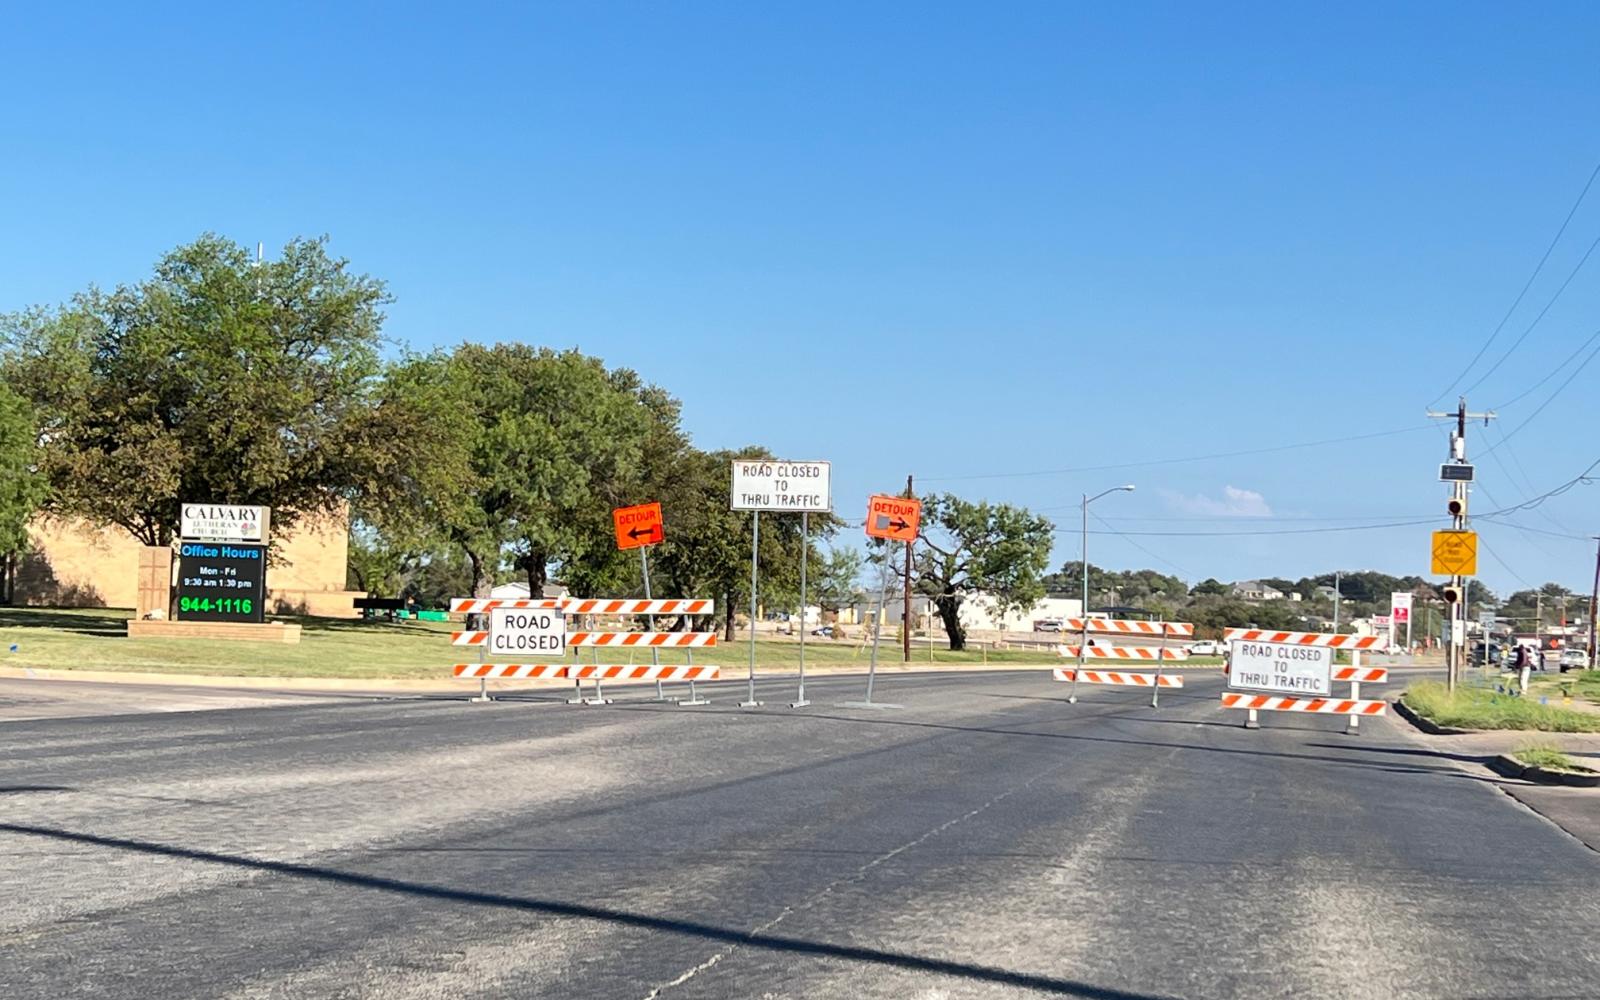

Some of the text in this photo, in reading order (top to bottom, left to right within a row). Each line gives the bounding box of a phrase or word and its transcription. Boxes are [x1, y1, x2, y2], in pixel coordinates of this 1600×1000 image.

[743, 465, 819, 478] ROAD CLOSED
[774, 480, 788, 491] TO
[742, 494, 820, 507] THRU TRAFFIC
[185, 506, 259, 521] CALVARY
[874, 502, 914, 516] DETOUR
[193, 520, 239, 528] LUTHERAN
[619, 510, 656, 525] DETOUR
[181, 545, 259, 559] Office Hours
[199, 566, 218, 575] Mon
[224, 567, 237, 576] Fri
[203, 579, 217, 587] am
[219, 579, 236, 587] 1:30
[237, 580, 252, 589] pm
[180, 597, 252, 614] 944-1116
[505, 615, 551, 629] ROAD
[496, 635, 559, 650] CLOSED
[1242, 644, 1321, 661] ROAD CLOSED
[1274, 660, 1288, 673] TO
[1240, 672, 1320, 690] THRU TRAFFIC
